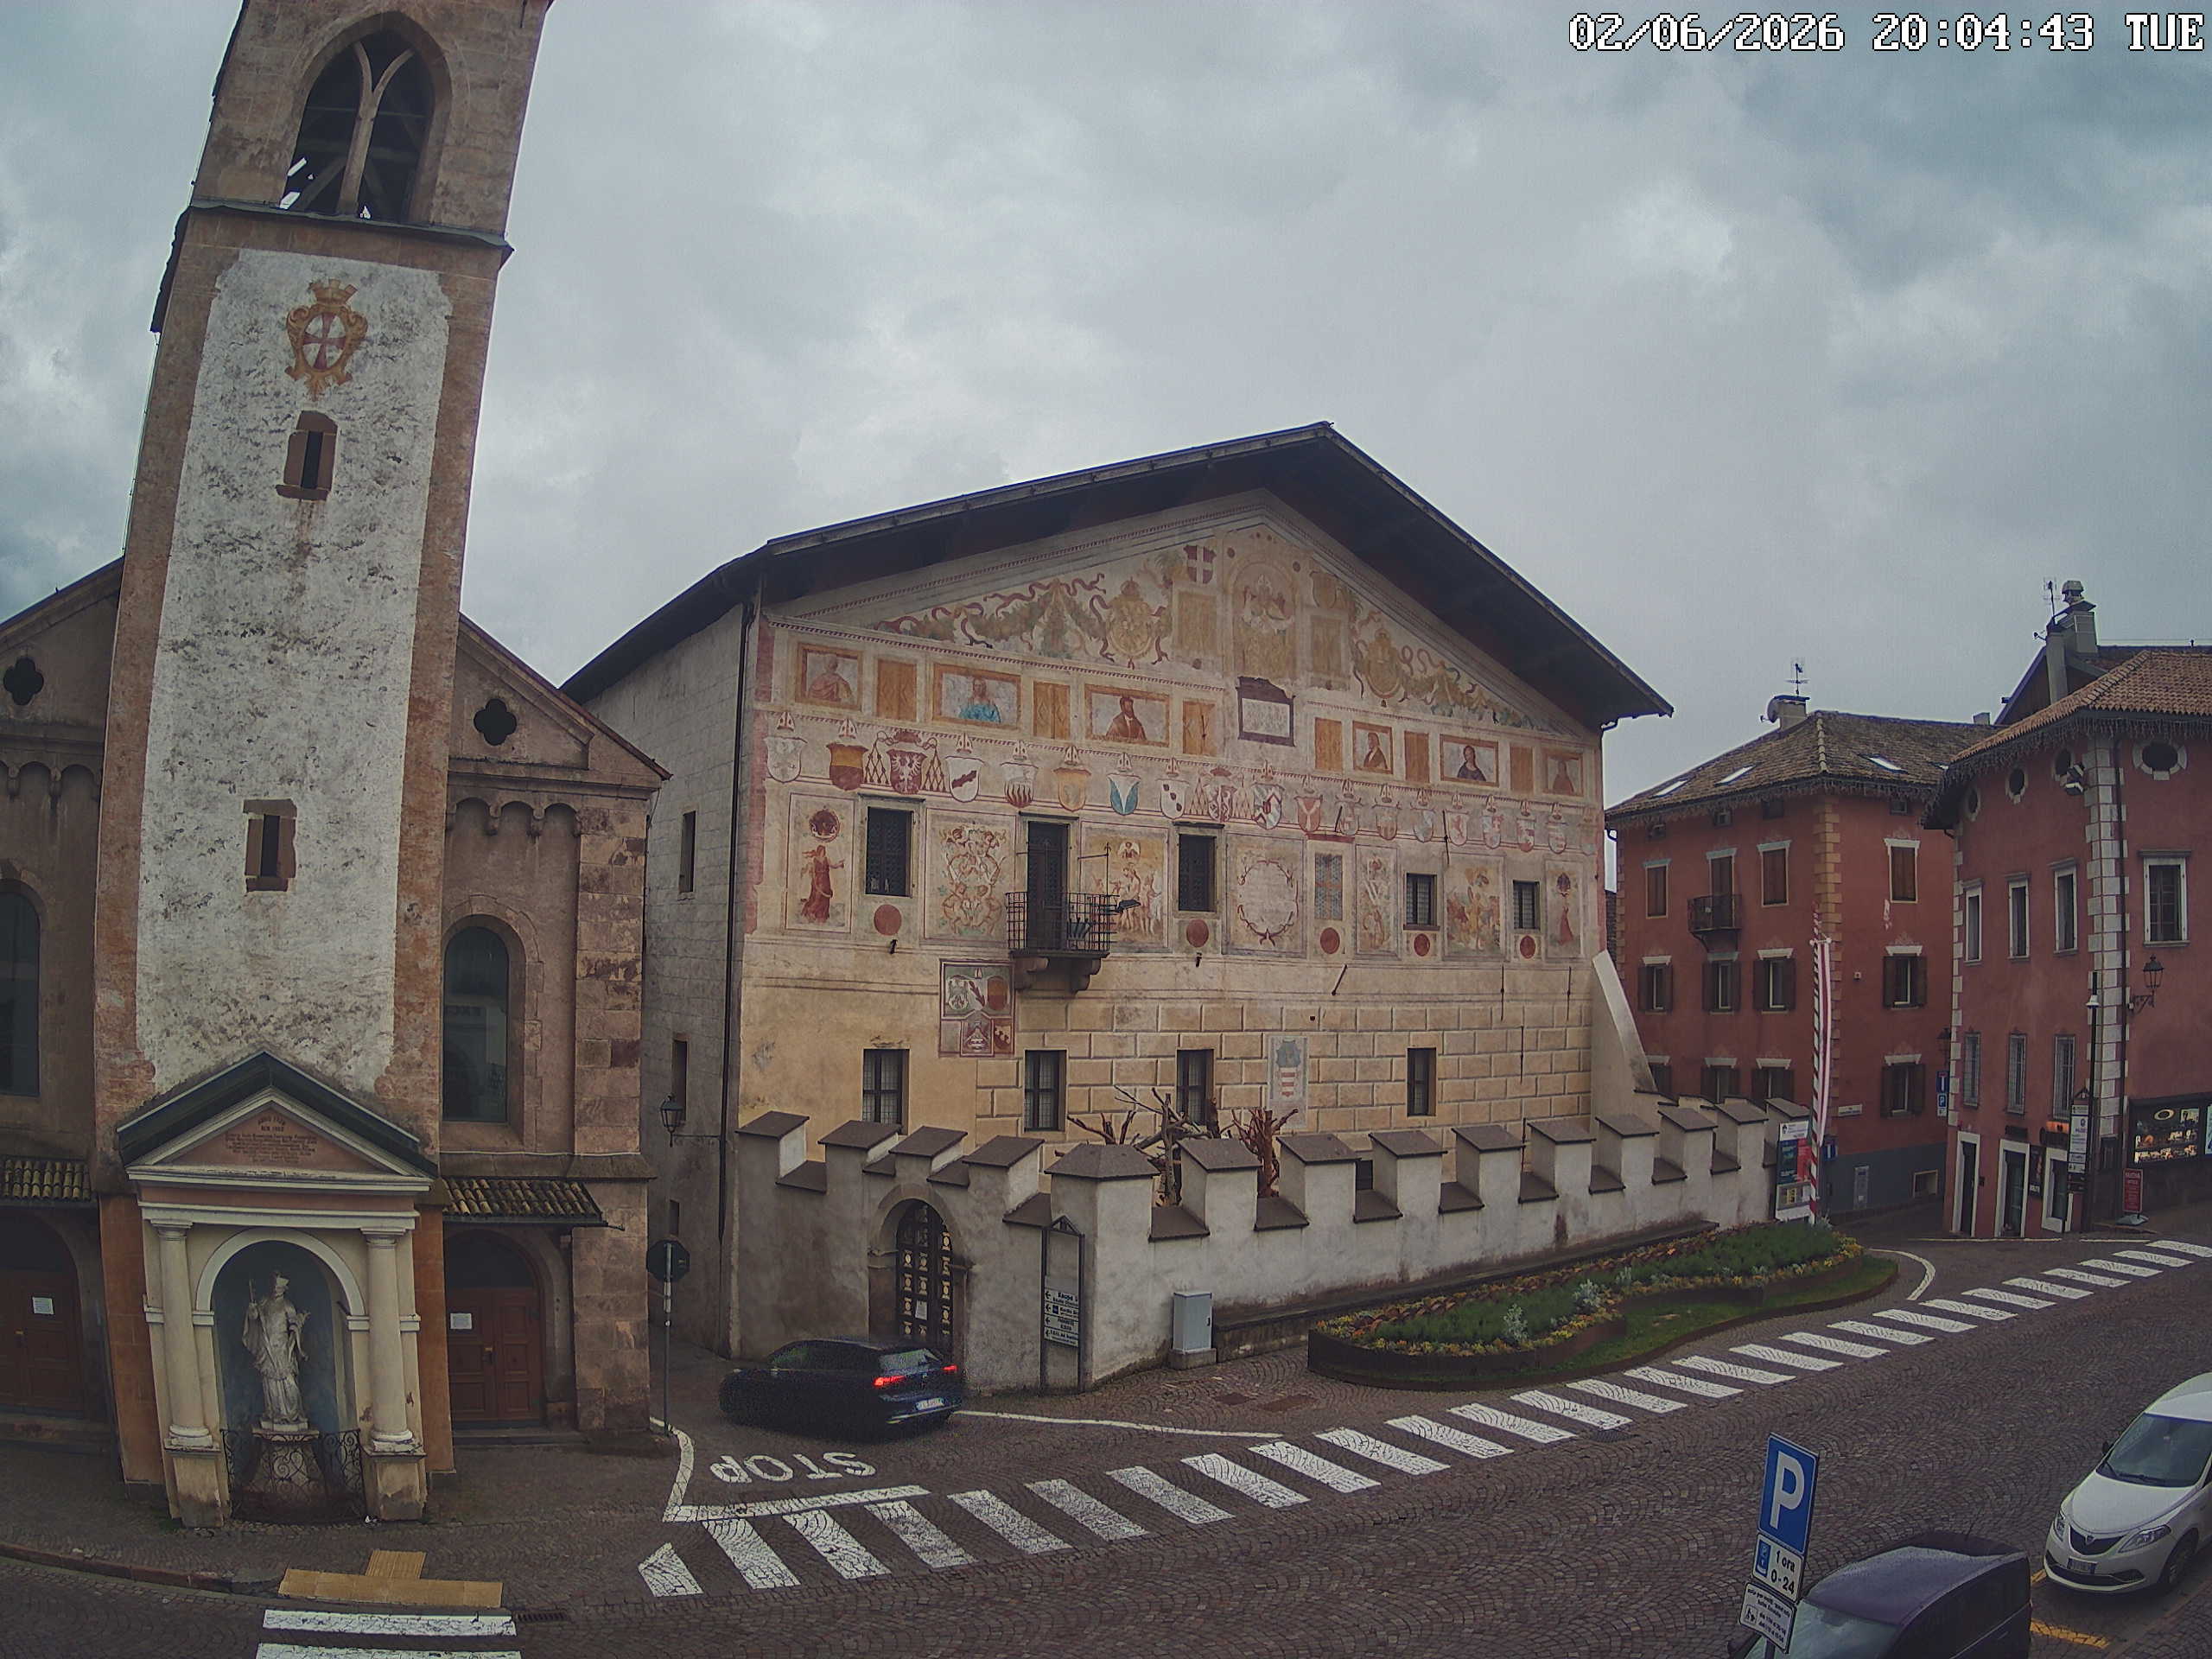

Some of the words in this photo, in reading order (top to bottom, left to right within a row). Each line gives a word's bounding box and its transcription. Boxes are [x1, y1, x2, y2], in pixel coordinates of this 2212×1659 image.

[710, 1452, 877, 1484] STOP
[1770, 1451, 1805, 1529] P
[1782, 1557, 1795, 1573] ora
[1770, 1568, 1795, 1594] 0-24
